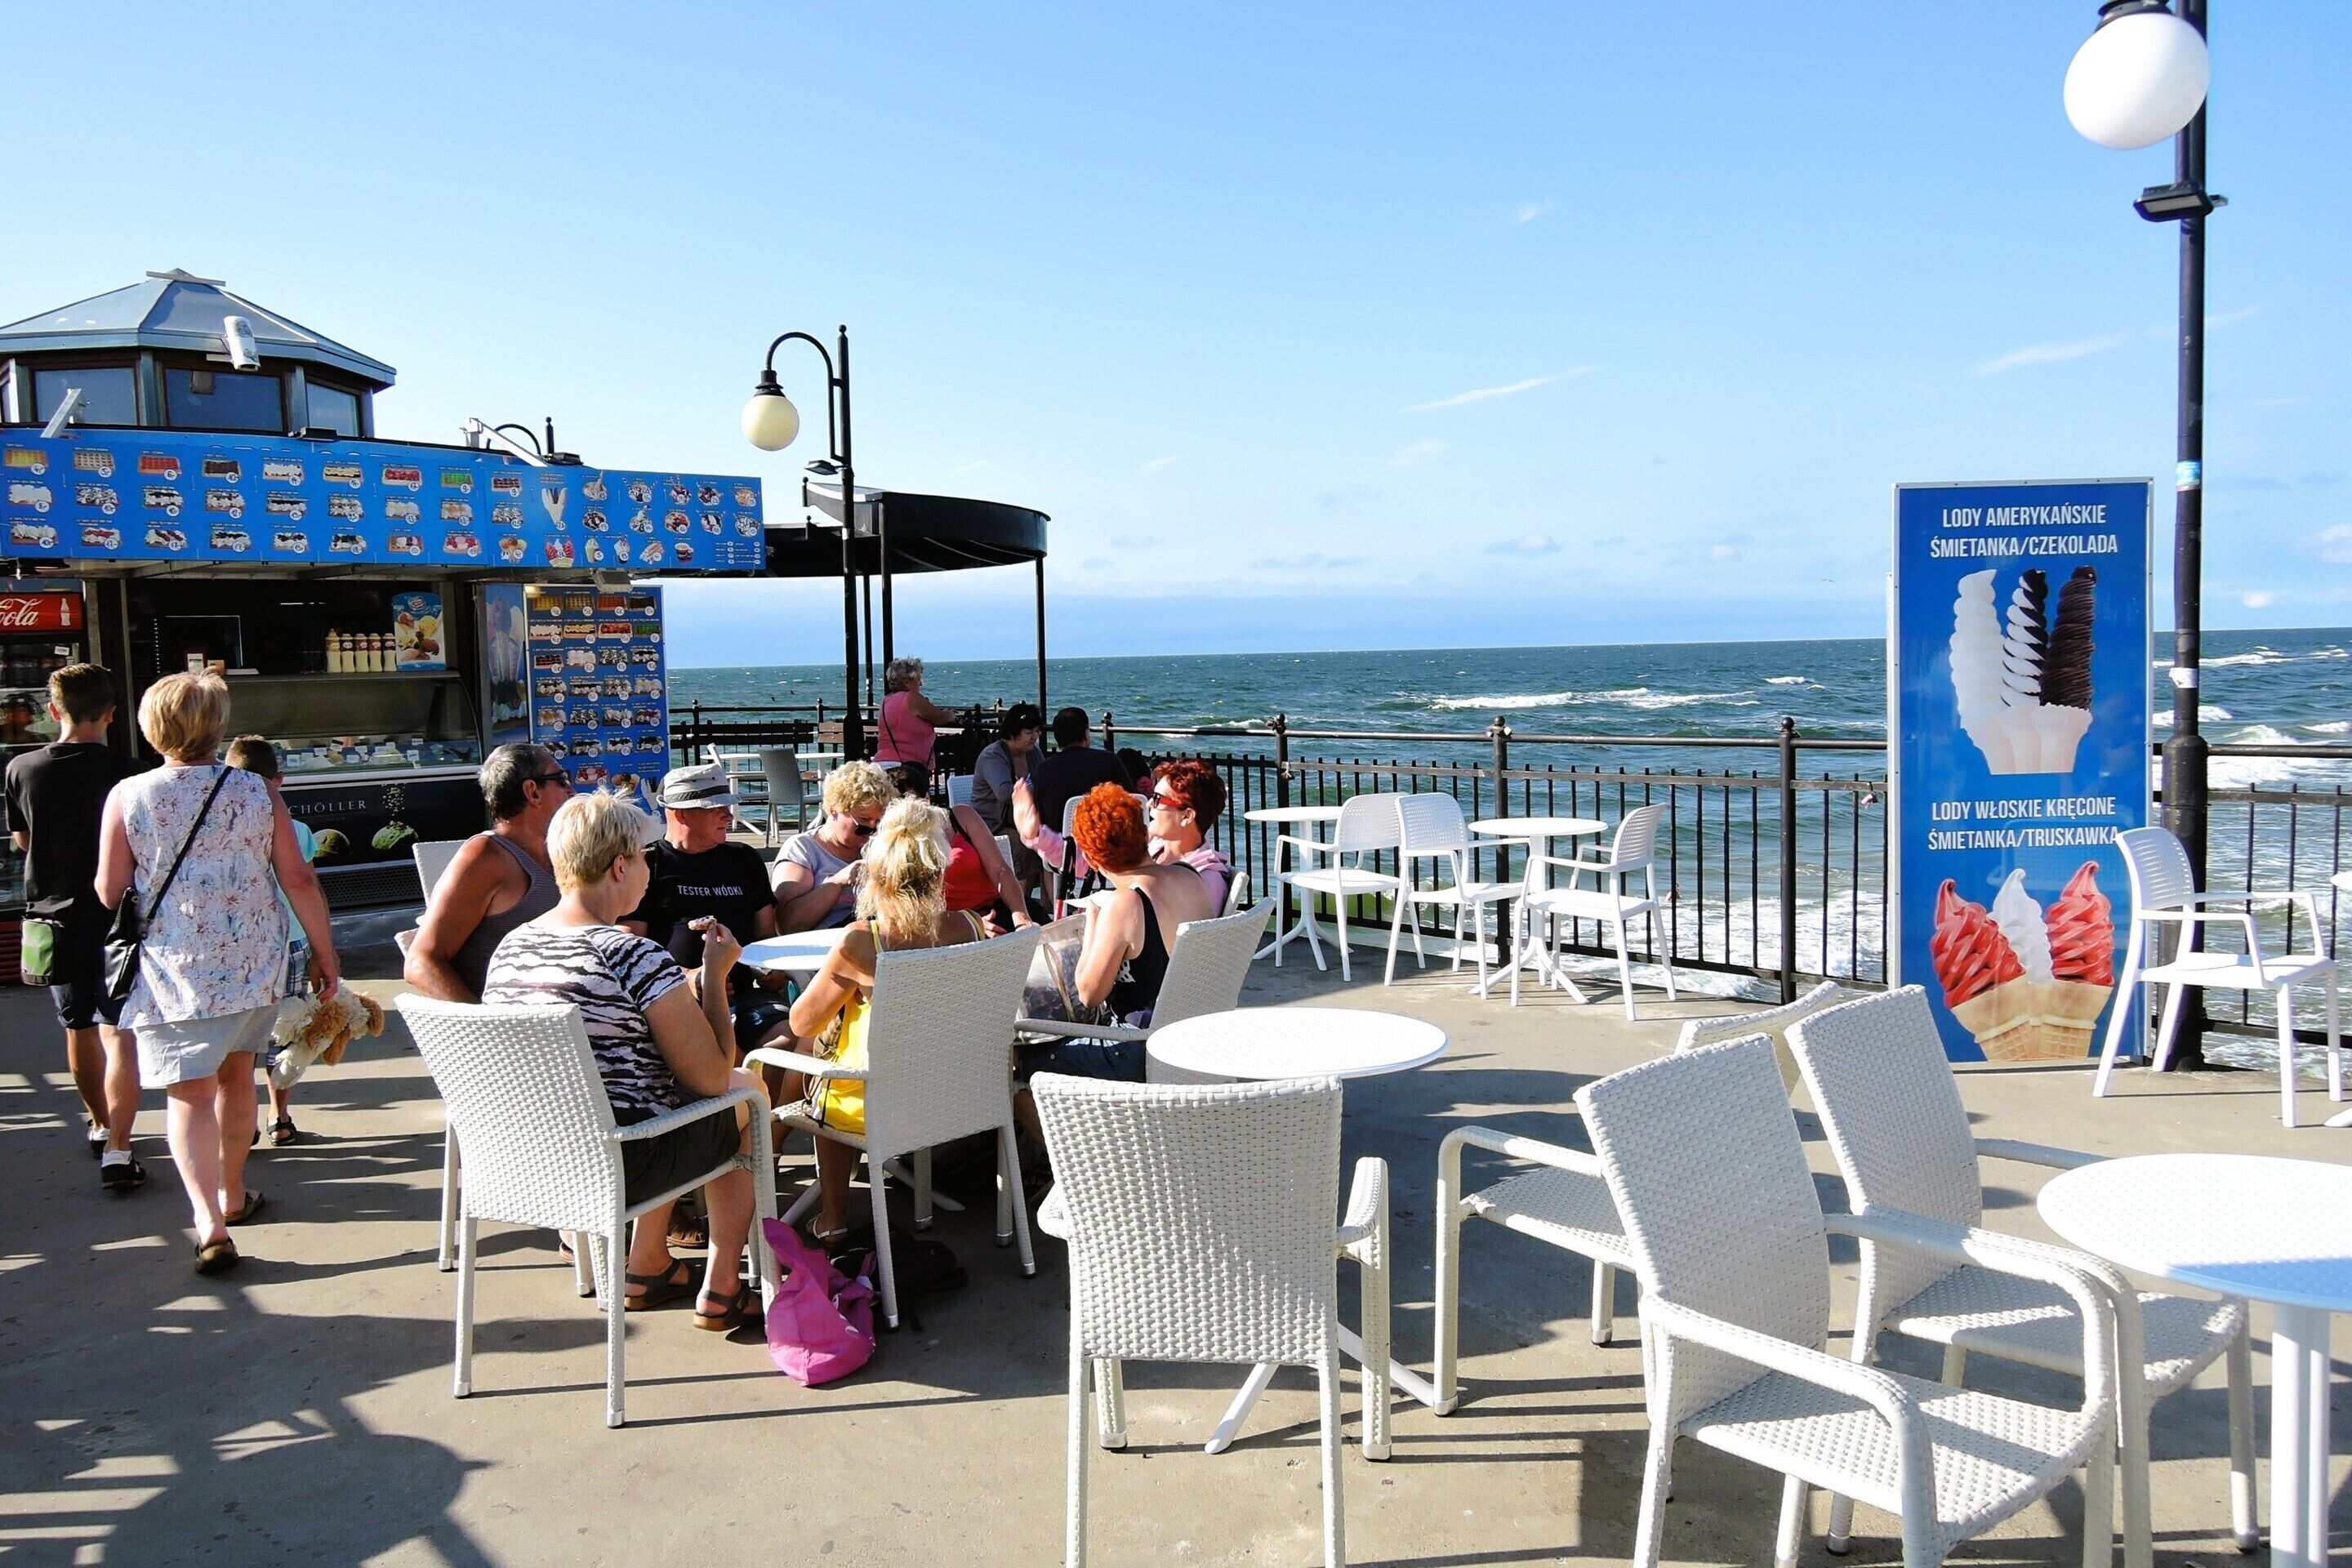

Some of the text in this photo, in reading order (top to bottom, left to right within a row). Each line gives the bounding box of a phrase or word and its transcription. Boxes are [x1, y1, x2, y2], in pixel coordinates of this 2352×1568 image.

[1943, 502, 2106, 528] LODY AMERYKAŃSKIE
[1930, 534, 2118, 558] ŚMIETANKA/CZEKOLADA
[287, 800, 366, 815] CHÖLLER
[1932, 796, 2117, 821] LODY WŁOSKIE KRĘCONE
[1928, 826, 2118, 850] ŚMIETANKA/TRUSKAWKA
[677, 884, 744, 897] TESTER WÓDKI
